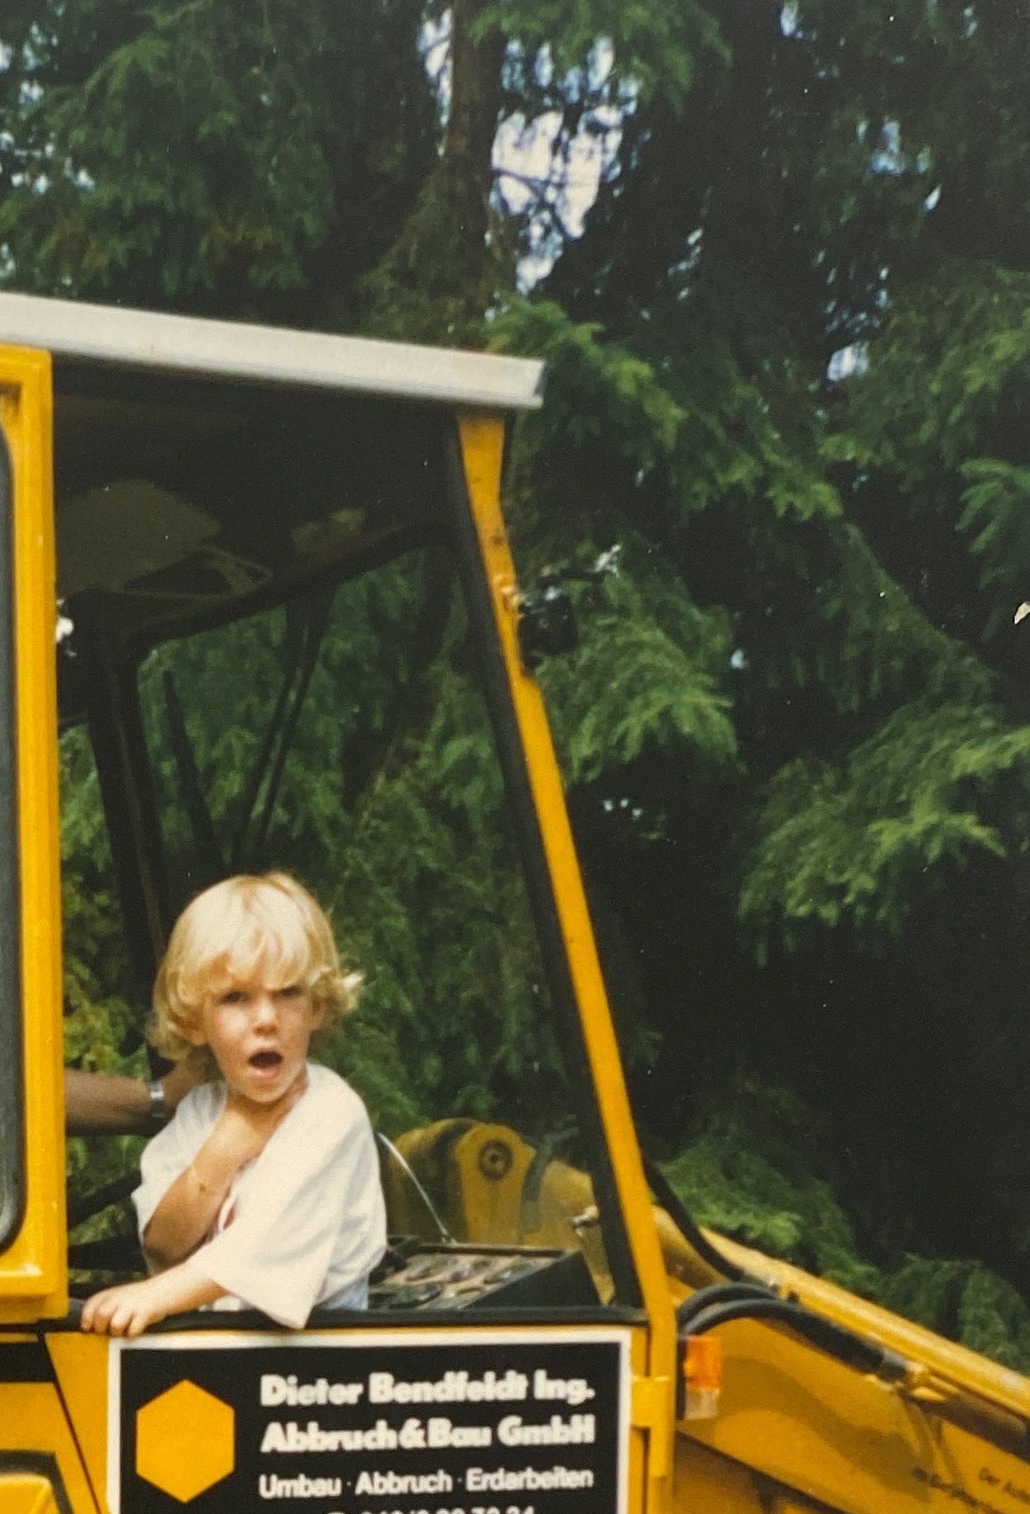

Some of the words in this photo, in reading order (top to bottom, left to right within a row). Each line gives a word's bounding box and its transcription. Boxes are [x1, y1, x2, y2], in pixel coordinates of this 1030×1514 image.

[260, 1375, 363, 1406] Dieter
[368, 1370, 529, 1404] Bendfeldt
[533, 1369, 596, 1405] Ing.
[496, 1413, 596, 1446] GmbH
[258, 1473, 342, 1499] Umbau
[354, 1469, 453, 1496] Abbruch
[465, 1465, 595, 1492] Erdarbeiten
